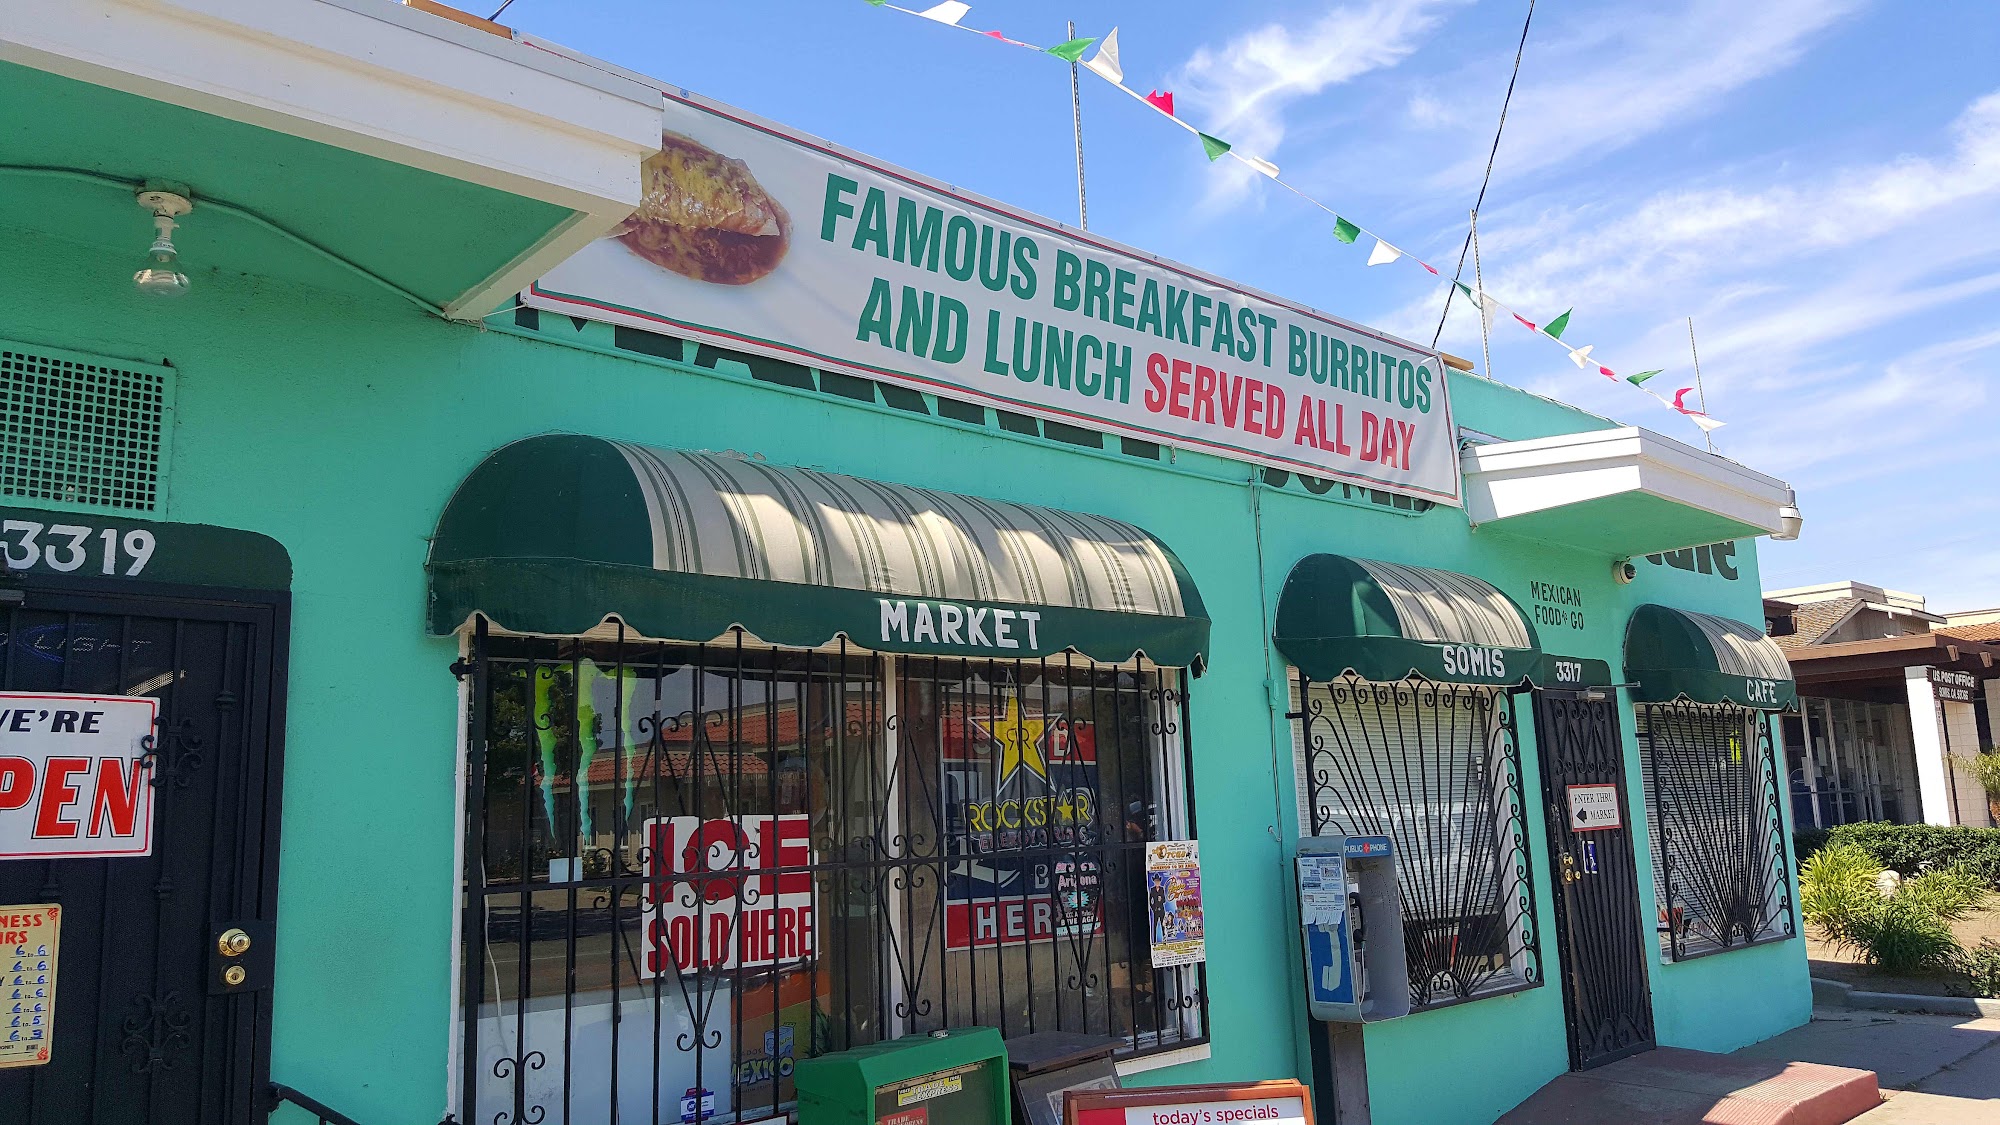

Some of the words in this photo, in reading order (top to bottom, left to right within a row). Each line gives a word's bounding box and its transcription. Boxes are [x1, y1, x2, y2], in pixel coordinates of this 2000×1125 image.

[820, 172, 1039, 300] FAMOUS
[1053, 249, 1278, 368] BREAKFAST
[1288, 323, 1432, 414] BURRITOS
[856, 277, 969, 364] AND
[984, 310, 1132, 404] LUNCH
[1144, 352, 1286, 440] SERVED
[1295, 394, 1351, 457] ALL
[1359, 410, 1416, 471] DAY
[0, 519, 156, 576] 3319
[1530, 580, 1581, 607] MEXICAN
[880, 599, 1041, 650] MARKET
[1534, 604, 1561, 625] FOOD
[1570, 611, 1584, 630] GO
[1443, 645, 1505, 678] SOMIS
[1555, 662, 1581, 682] 3317
[1941, 671, 1955, 685] POST
[1955, 673, 1975, 688] OFFICE
[1746, 679, 1777, 704] CAFE
[1574, 793, 1594, 803] ENTER
[1596, 792, 1613, 803] THRU
[1590, 809, 1615, 820] MARKET
[1344, 845, 1362, 853] PUBLIC
[1370, 843, 1387, 851] PHONE
[649, 819, 811, 905] ICE
[977, 903, 1052, 940] HER
[648, 912, 730, 973] SOLD
[741, 905, 812, 963] HERE
[16, 945, 25, 956] 6
[13, 961, 23, 971] 6
[13, 975, 23, 985] 6
[12, 989, 21, 999] 6
[12, 1002, 21, 1013] 6
[11, 1015, 20, 1027] 6
[9, 1030, 19, 1041] 6
[911, 1080, 945, 1094] TRADE
[917, 1083, 960, 1101] EXPRESS
[1153, 1109, 1211, 1125] today's
[1216, 1104, 1279, 1124] specials
